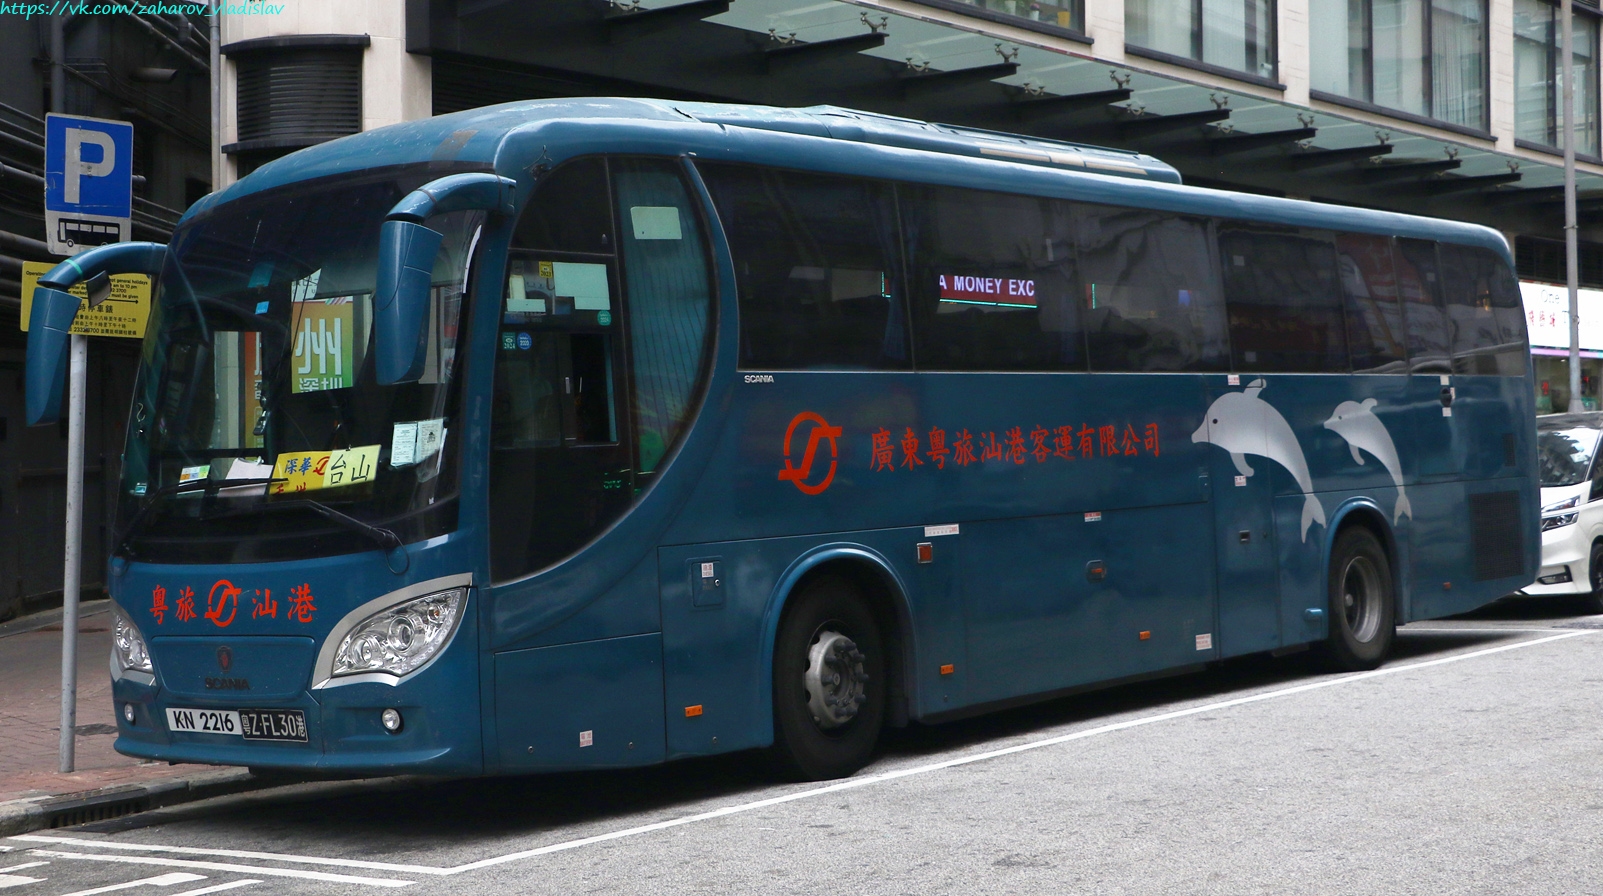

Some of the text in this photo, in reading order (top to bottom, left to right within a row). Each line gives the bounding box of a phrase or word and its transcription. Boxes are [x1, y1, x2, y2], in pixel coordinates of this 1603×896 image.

[64, 127, 116, 204] P
[953, 275, 1002, 294] MONEY
[1008, 279, 1035, 297] EXC
[295, 318, 342, 375] 州
[744, 374, 775, 384] SCANIA
[330, 454, 371, 485] 台山
[252, 583, 317, 623] 汕港
[204, 676, 251, 691] SCANIA
[173, 711, 235, 732] KN 2216
